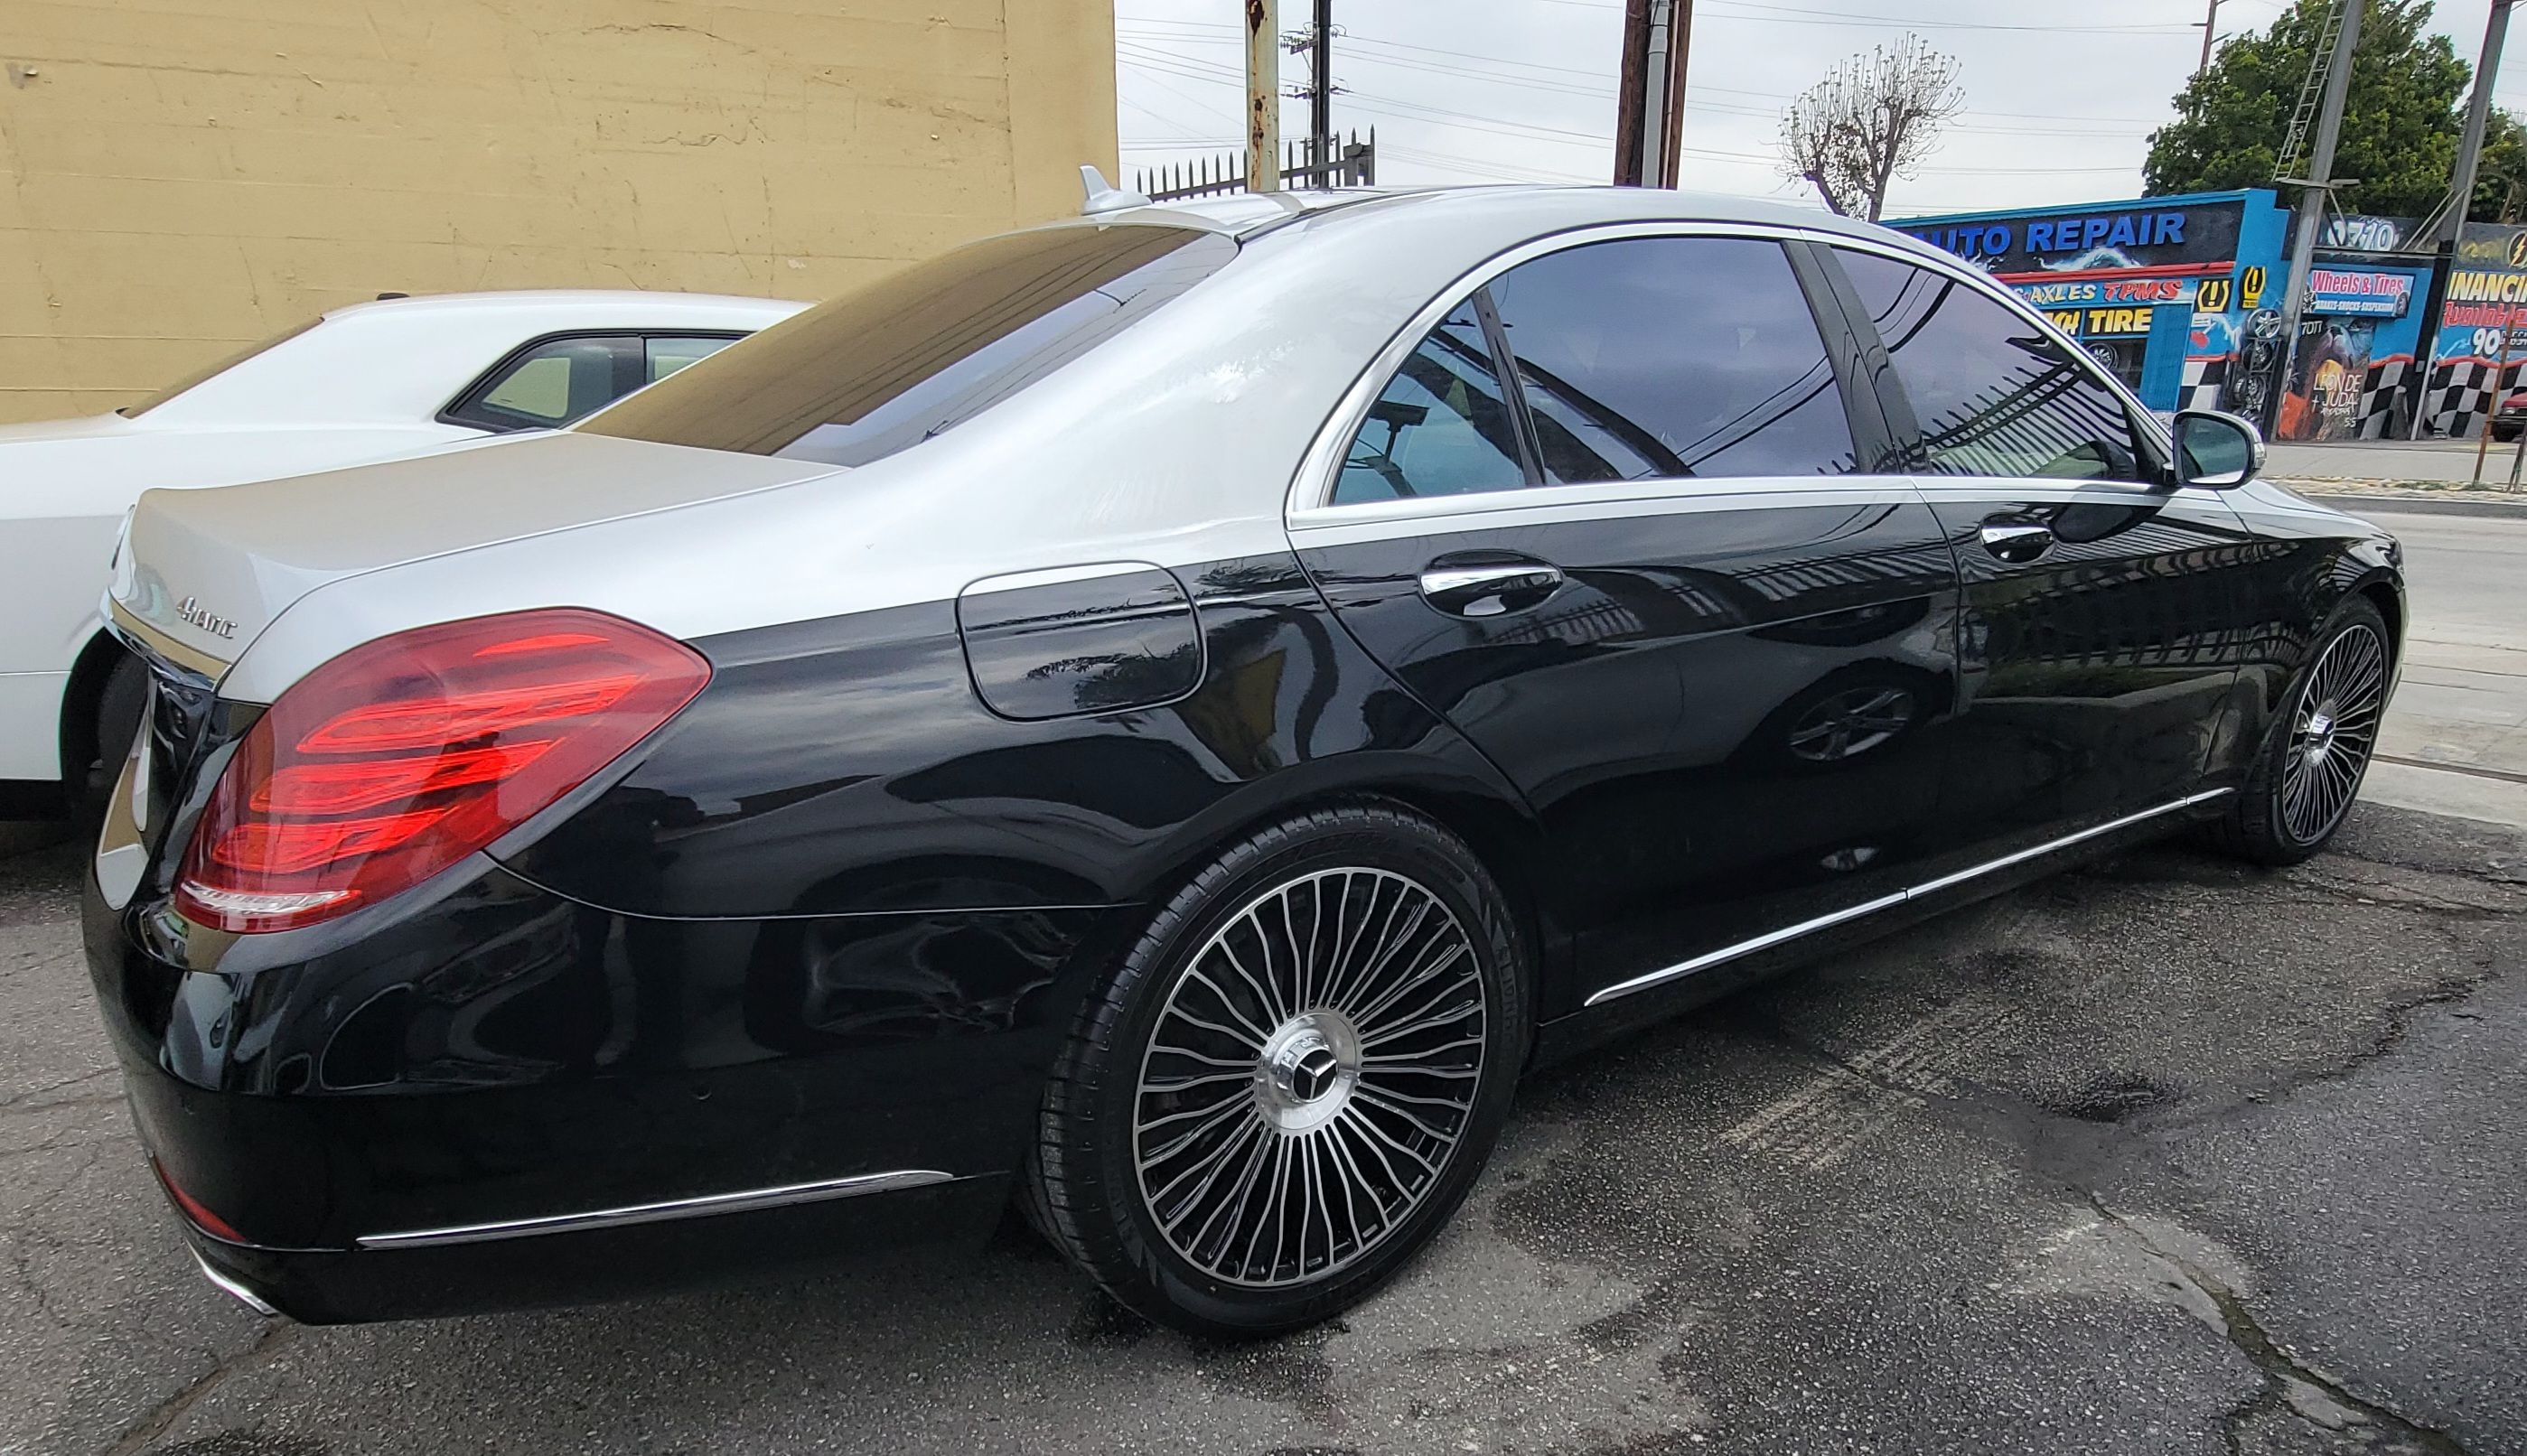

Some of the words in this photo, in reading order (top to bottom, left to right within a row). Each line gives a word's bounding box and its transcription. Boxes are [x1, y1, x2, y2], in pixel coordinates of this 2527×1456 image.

[2025, 211, 2185, 253] REPAIR
[2030, 284, 2097, 304] AXLES
[2103, 280, 2183, 301] TPMS
[2312, 270, 2360, 294] Wheels
[2361, 275, 2371, 294] &
[2373, 273, 2404, 296] Tires
[2447, 271, 2527, 303] INANCI
[2089, 308, 2154, 333] TIRE
[2473, 328, 2501, 354] 90
[2344, 375, 2362, 392] DE
